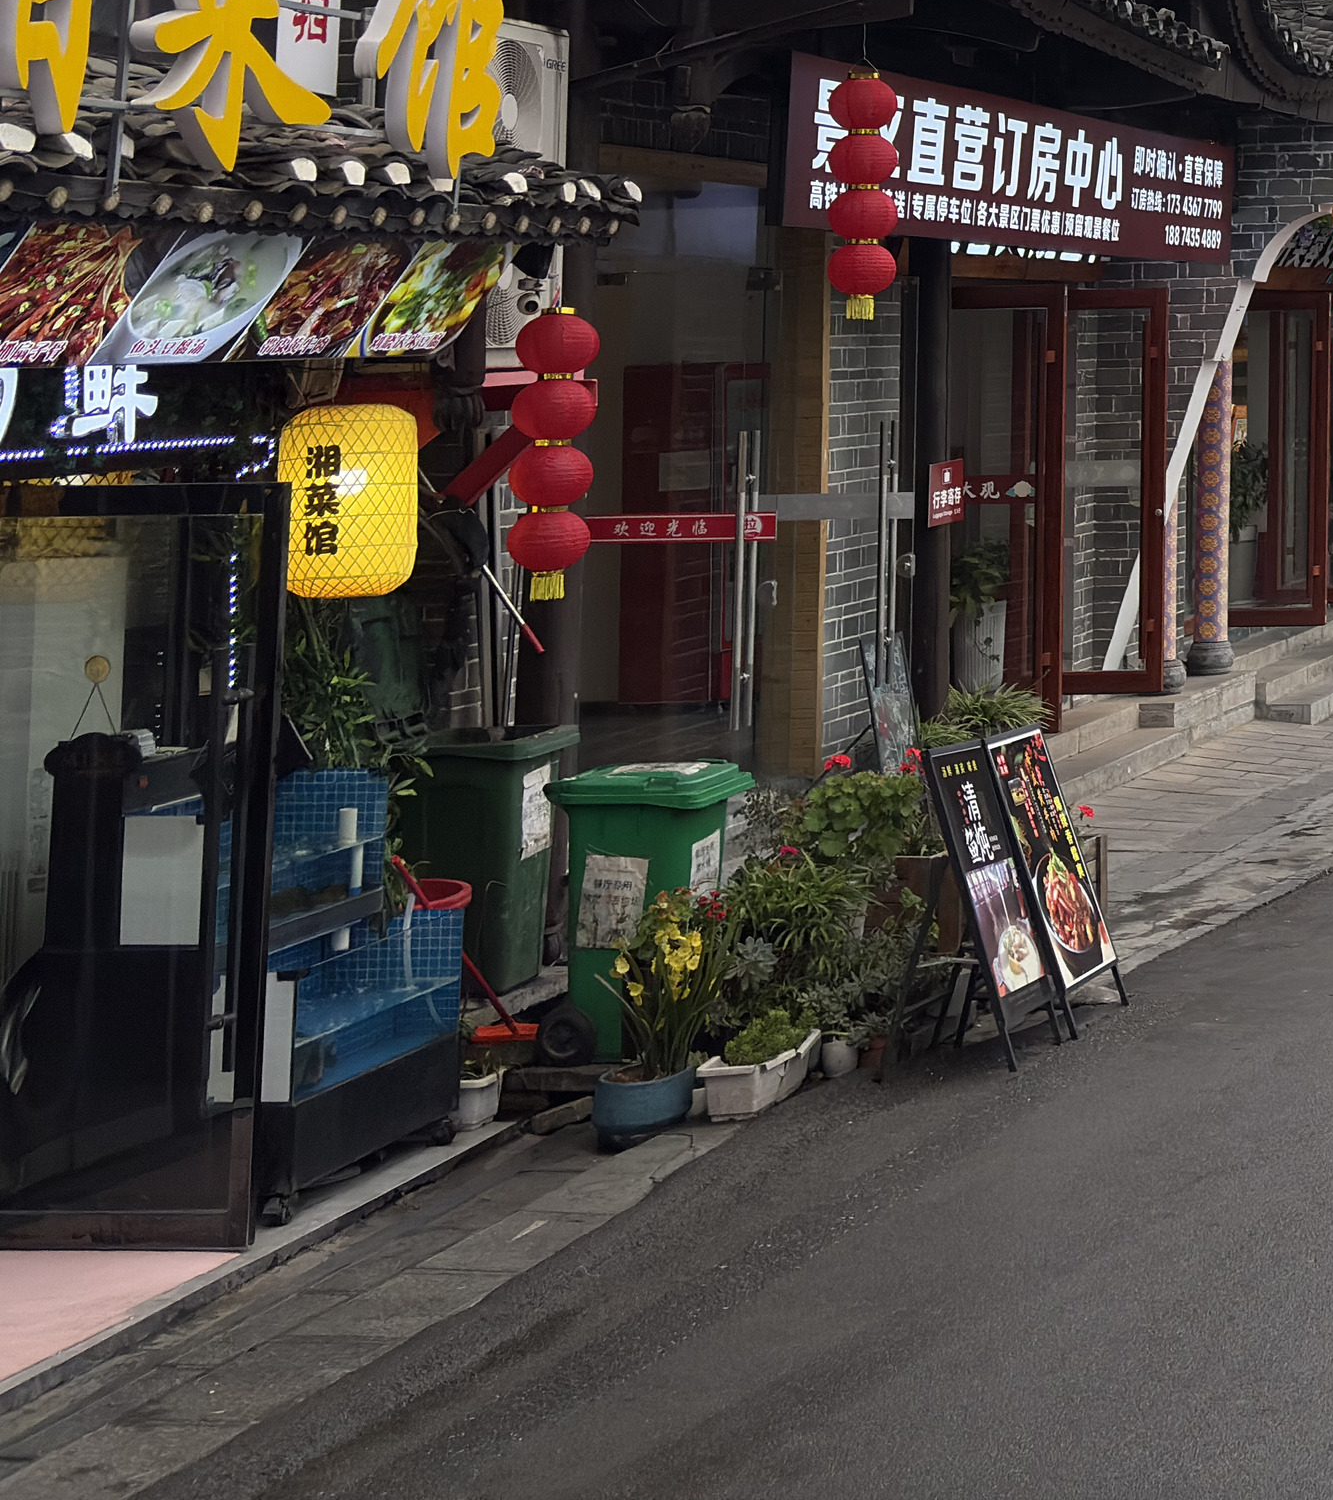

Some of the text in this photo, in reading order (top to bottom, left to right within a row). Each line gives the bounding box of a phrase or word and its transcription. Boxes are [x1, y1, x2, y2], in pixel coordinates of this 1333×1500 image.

[546, 58, 567, 73] GREE
[303, 444, 341, 557] 湘菜馆
[932, 486, 962, 510] 行李寄存
[613, 519, 708, 537] 欢迎光临
